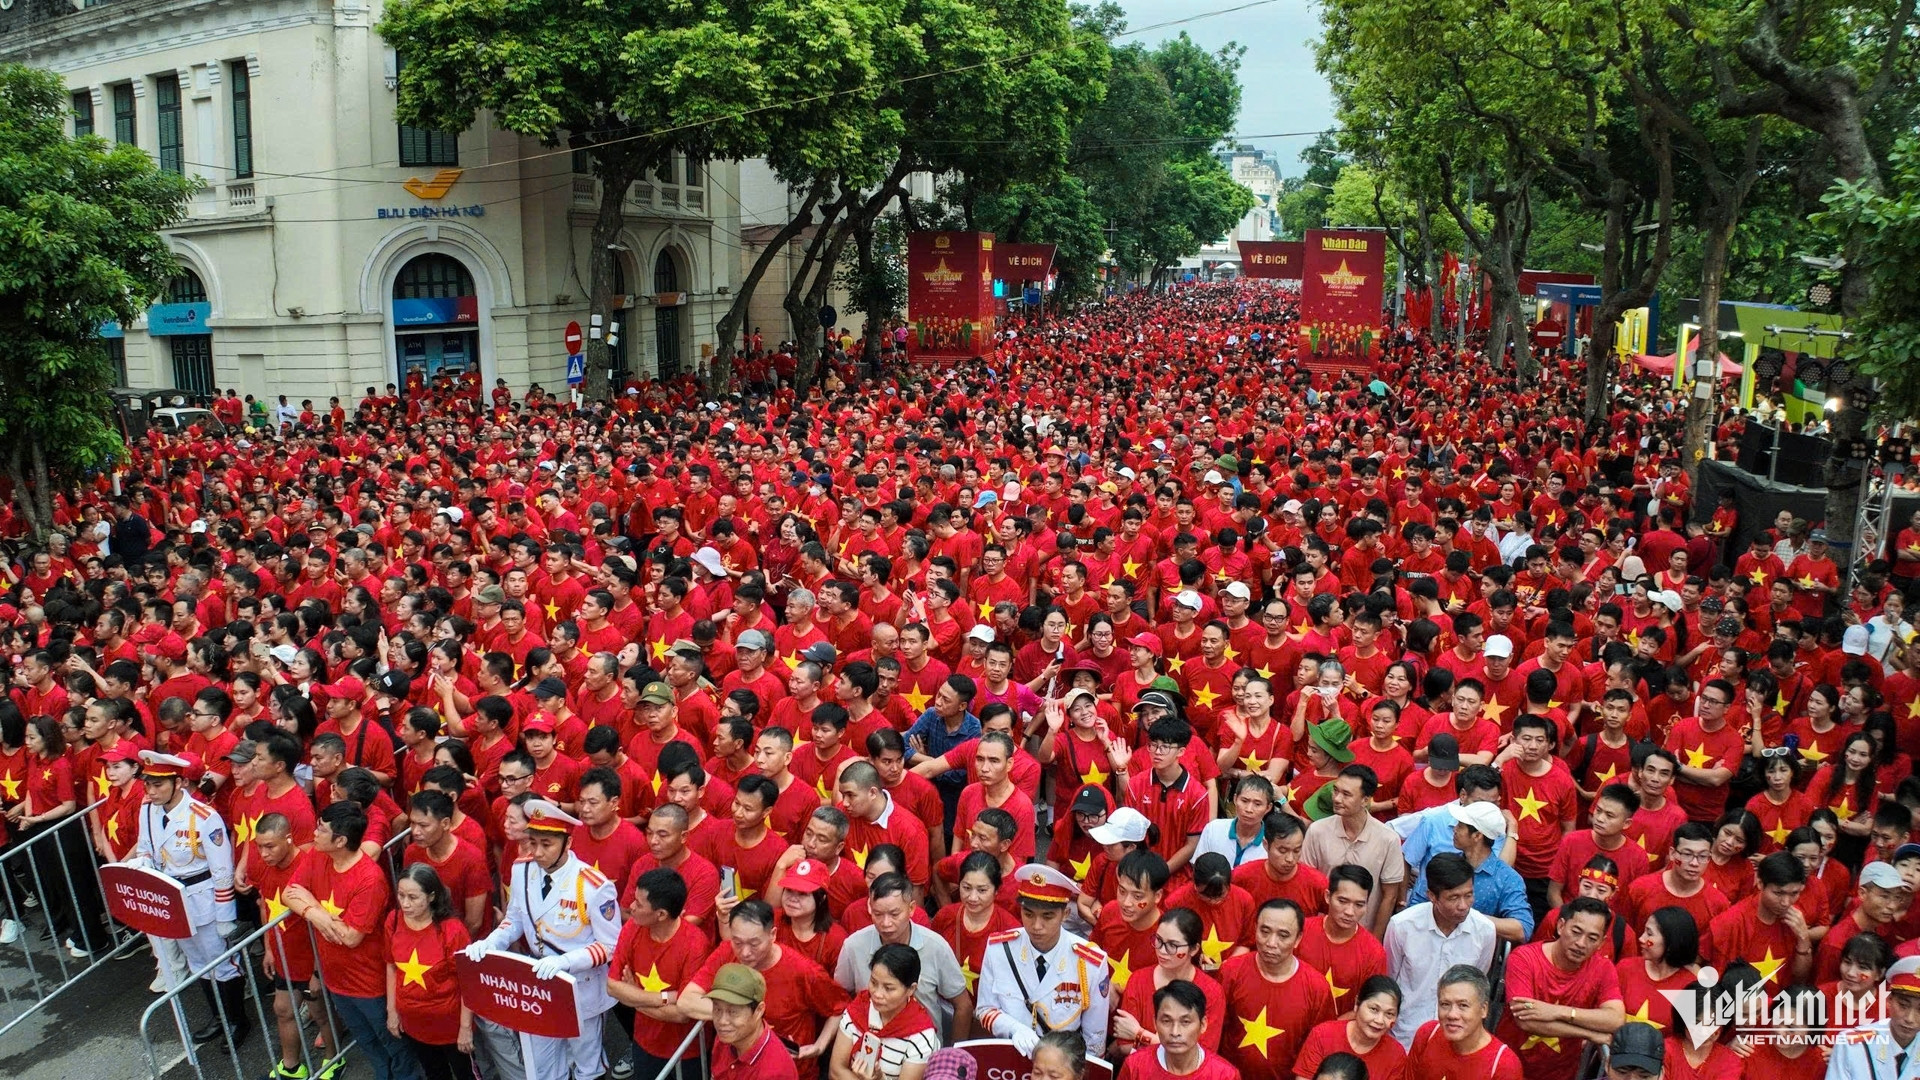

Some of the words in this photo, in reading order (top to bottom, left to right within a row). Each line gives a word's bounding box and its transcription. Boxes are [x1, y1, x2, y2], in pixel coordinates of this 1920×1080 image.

[377, 207, 404, 219] BƯU
[408, 205, 438, 219] ĐIỆN
[442, 204, 460, 217] HÀ
[463, 204, 485, 217] NỘI
[1322, 237, 1347, 249] Nhân
[1348, 238, 1368, 250] Dân
[1008, 256, 1020, 266] VỀ
[1022, 255, 1042, 266] ĐÍCH
[1251, 253, 1263, 264] VỀ
[1265, 253, 1288, 265] ĐÍCH
[943, 272, 962, 282] NAM
[1343, 276, 1365, 286] NAM
[115, 883, 134, 897] LỰC
[135, 888, 171, 906] LƯỢNG
[123, 898, 137, 911] VŨ
[137, 902, 171, 920] TRANG
[480, 972, 519, 993] NHÂN
[521, 984, 552, 1002] DÂN
[493, 992, 518, 1009] THỦ
[521, 1000, 543, 1015] ĐÔ
